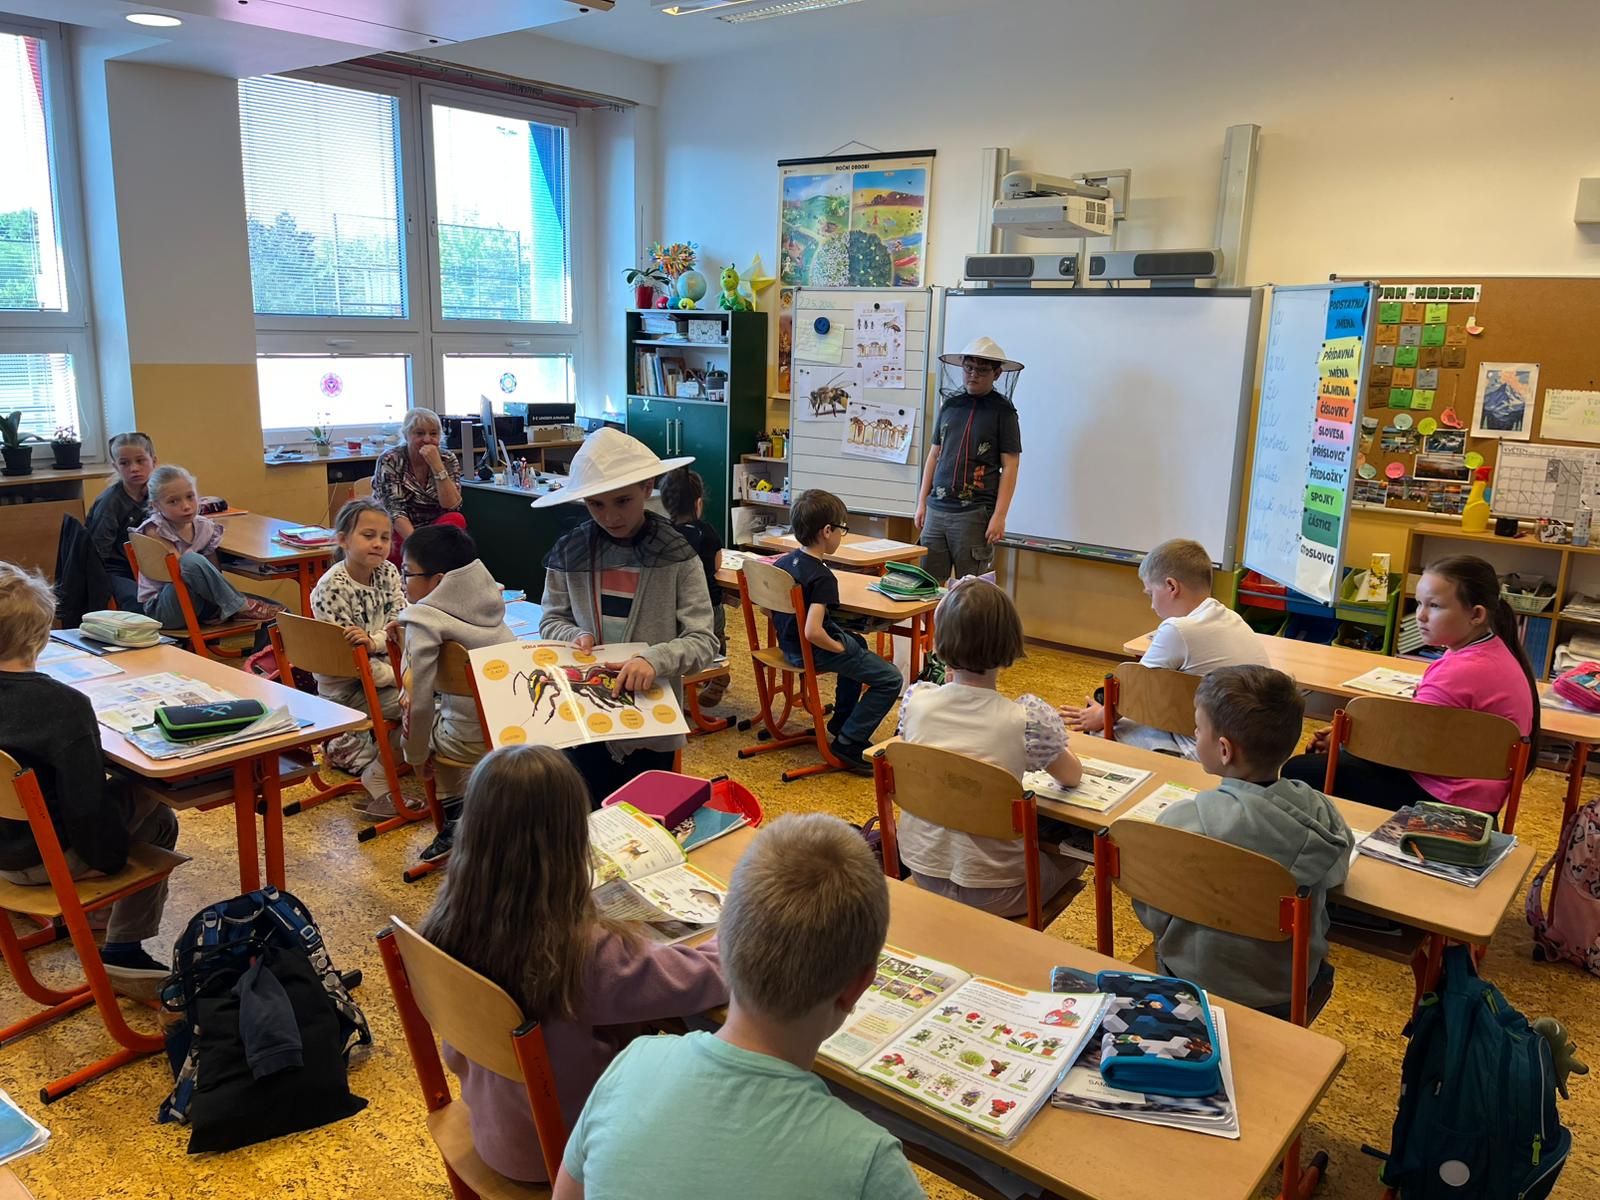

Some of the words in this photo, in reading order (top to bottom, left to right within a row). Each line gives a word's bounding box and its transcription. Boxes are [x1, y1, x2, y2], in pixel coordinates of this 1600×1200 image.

[1414, 286, 1475, 300] HODIN
[1322, 344, 1356, 361] PŘÍDAVNÁ
[1328, 365, 1349, 378] JMÉNA
[1322, 382, 1350, 397] ZÁJMENA
[1320, 401, 1349, 418] ČÍSLOVKY
[1318, 425, 1345, 441] SLOVESA
[1312, 443, 1346, 462] PŘÍSLOVCE
[1309, 466, 1344, 484] PŘEDLOŽKY
[1310, 491, 1335, 506] SPOJKY
[1307, 513, 1332, 532] ČÁSTICE
